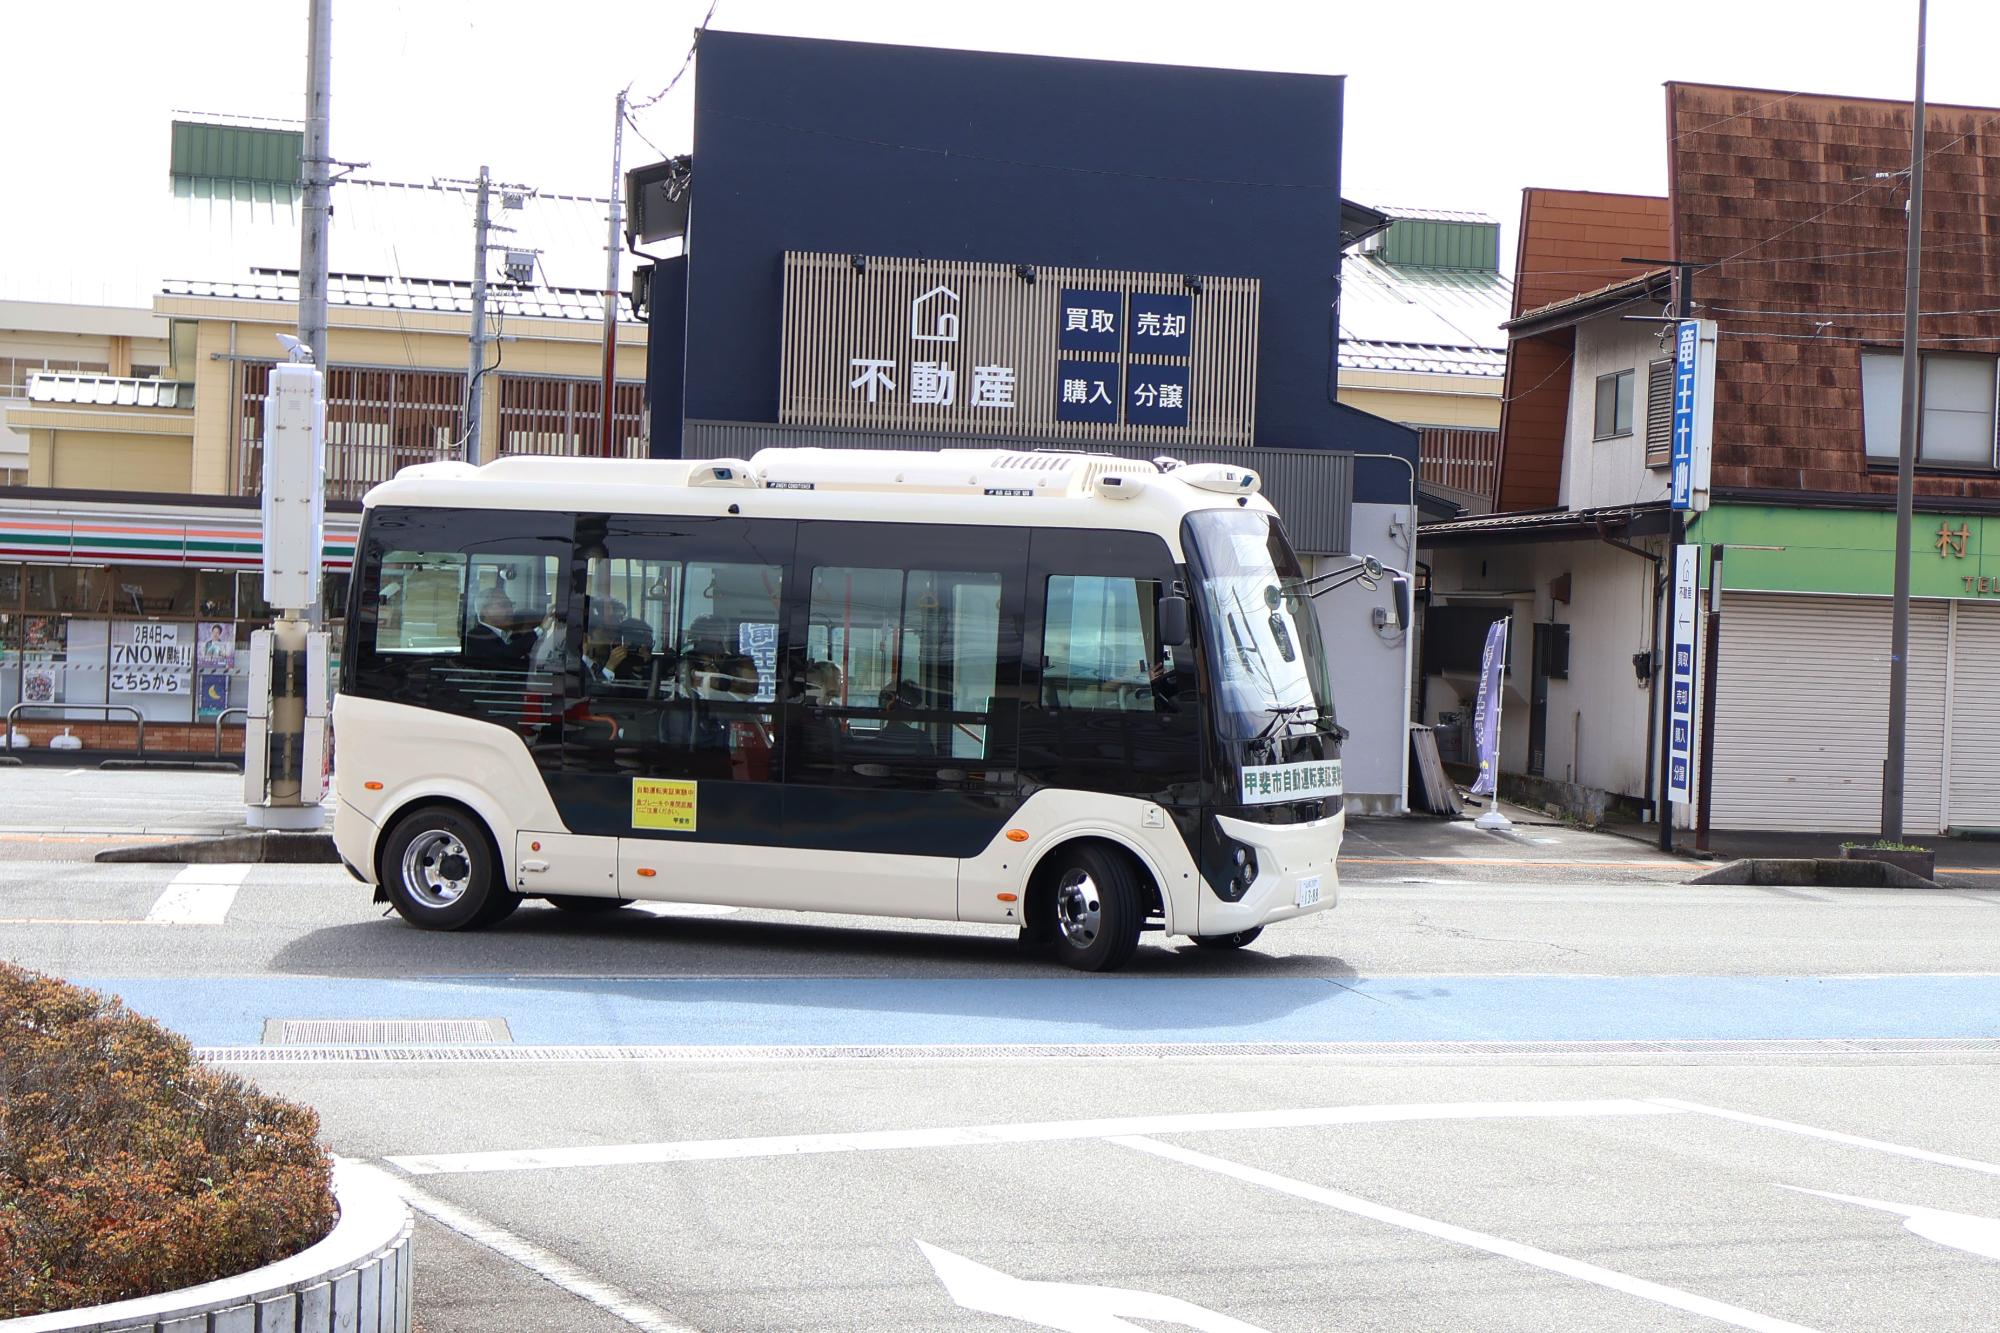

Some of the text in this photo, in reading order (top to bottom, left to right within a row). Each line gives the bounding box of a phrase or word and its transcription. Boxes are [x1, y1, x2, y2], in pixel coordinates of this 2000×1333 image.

[1066, 307, 1115, 333] 買取
[1137, 312, 1186, 337] 売却
[851, 358, 1016, 407] 不動産
[1062, 379, 1112, 405] 購入
[1134, 383, 1183, 408] 分譲
[1674, 329, 1694, 503] 竜王土地
[1935, 520, 1972, 559] 村
[1961, 575, 2000, 593] TEL
[1677, 651, 1689, 667] 買取
[111, 673, 178, 692] こちらから
[1676, 690, 1688, 706] 売却
[1674, 727, 1686, 744] 購入
